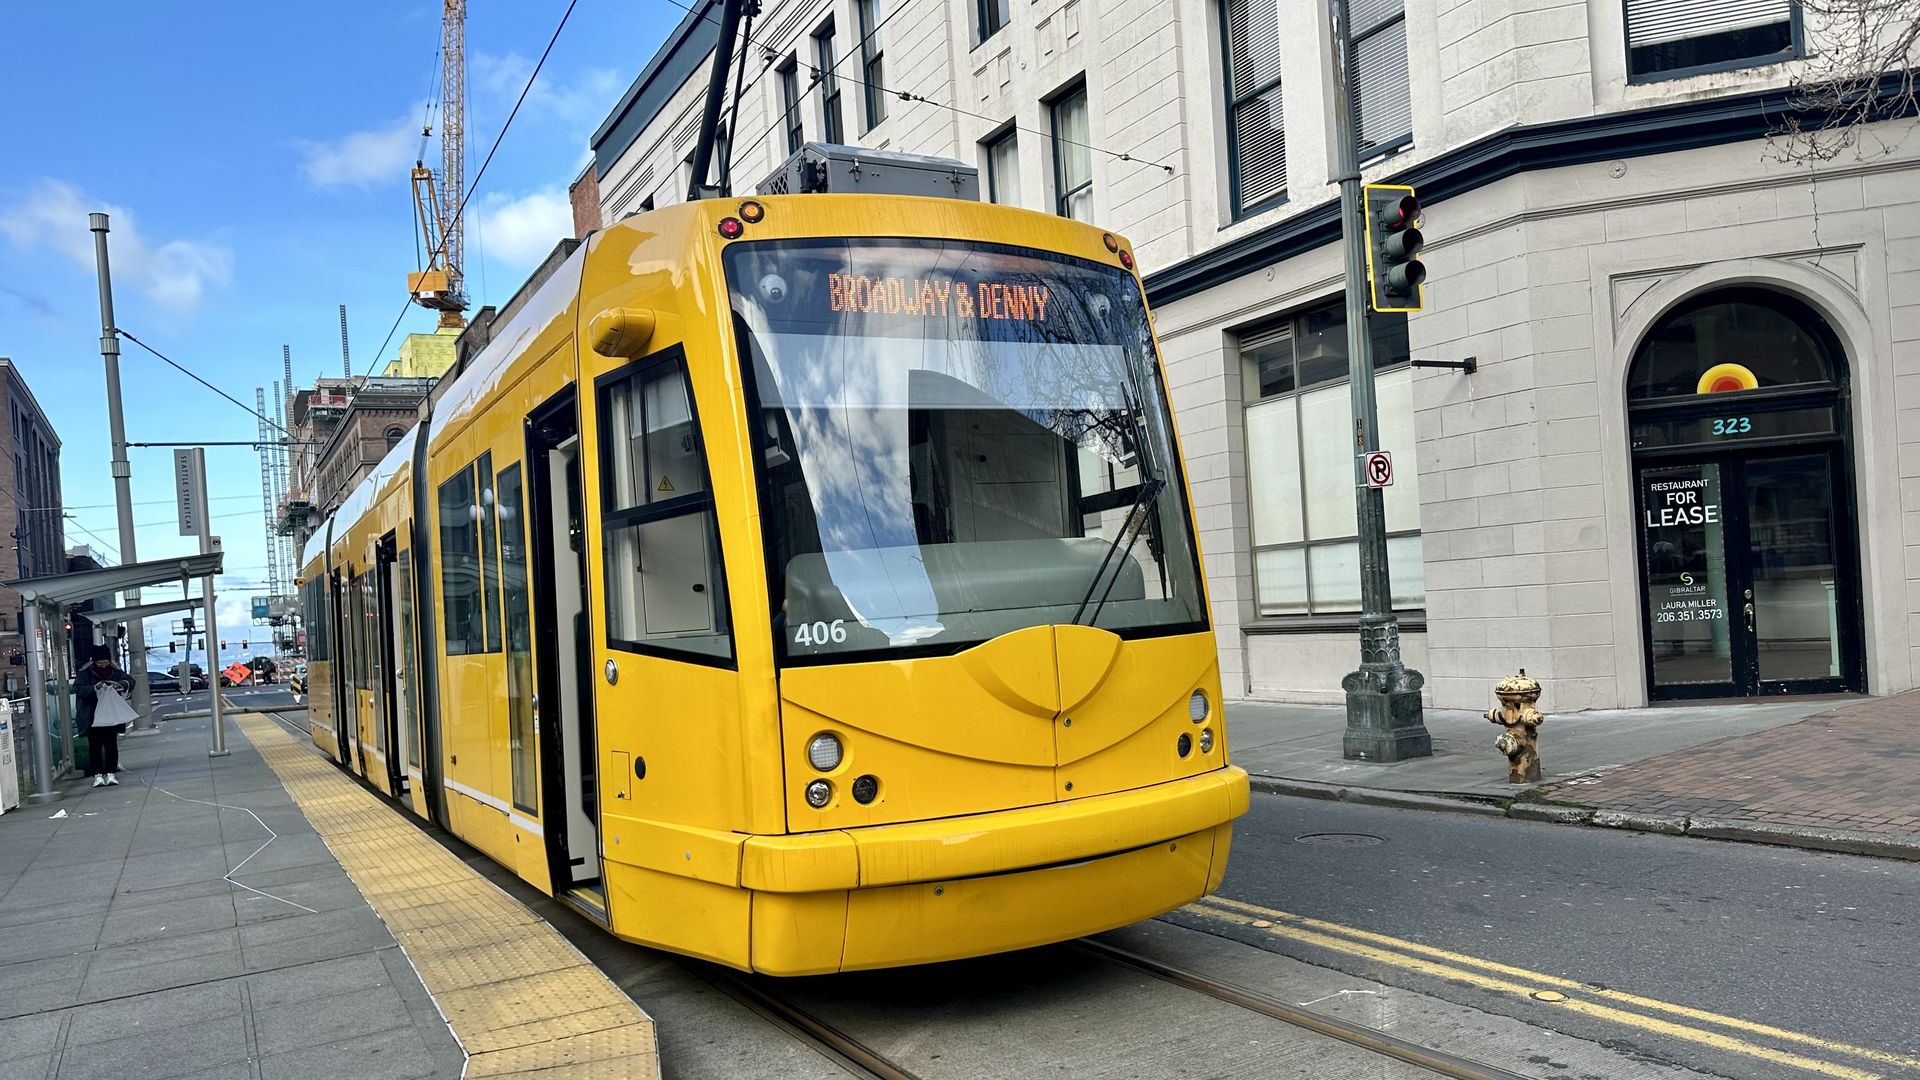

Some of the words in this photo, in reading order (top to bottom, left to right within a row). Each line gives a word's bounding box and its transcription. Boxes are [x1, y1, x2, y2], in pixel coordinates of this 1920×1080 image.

[828, 273, 951, 317] BROADWAY
[956, 281, 975, 318] &
[978, 283, 1049, 321] DENNY
[1711, 416, 1752, 436] 323
[180, 455, 189, 486] SEATTLE
[1651, 479, 1710, 491] RESTAURANT
[1666, 491, 1697, 505] FOR
[182, 488, 192, 530] STREETCAR
[1646, 504, 1718, 528] LEASE
[1669, 585, 1706, 594] GIBRALTAR
[1660, 601, 1687, 610] LAURA
[1688, 599, 1717, 608] MILLER
[1656, 609, 1723, 623] 206.351.3573
[794, 619, 847, 647] 406
